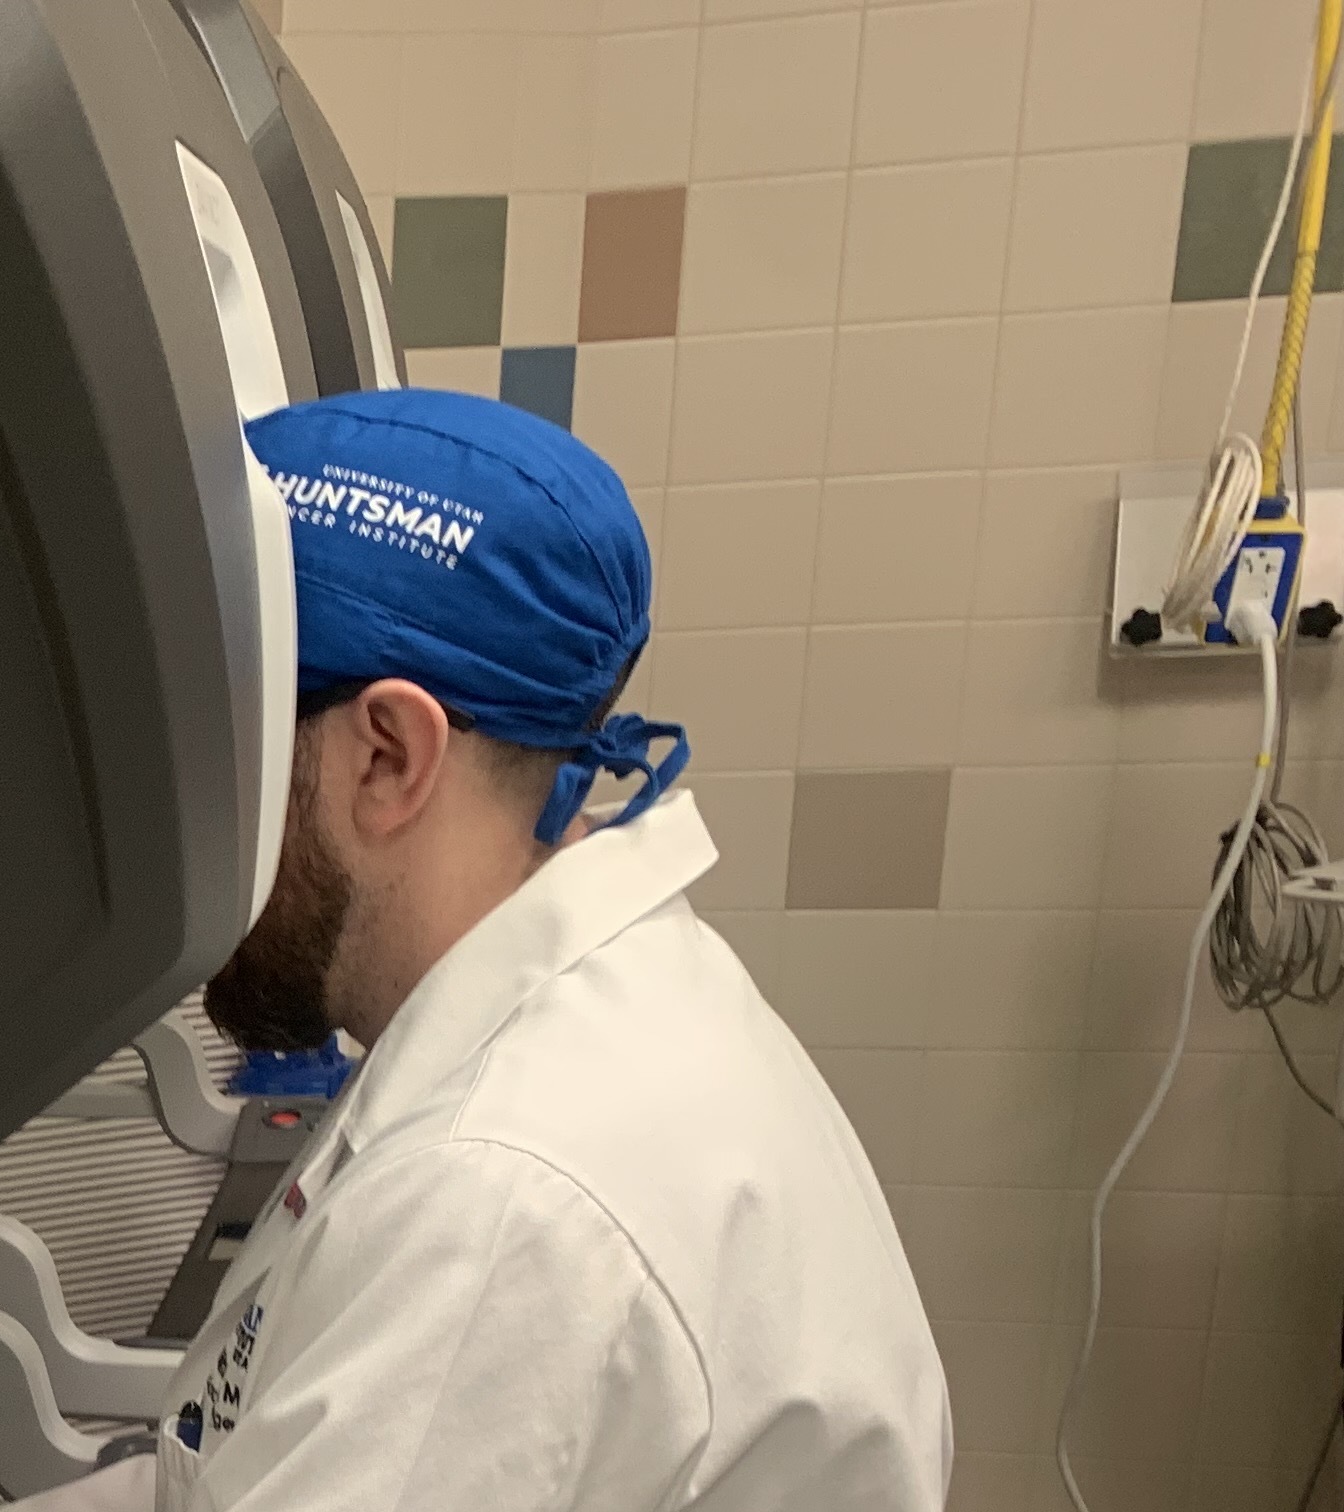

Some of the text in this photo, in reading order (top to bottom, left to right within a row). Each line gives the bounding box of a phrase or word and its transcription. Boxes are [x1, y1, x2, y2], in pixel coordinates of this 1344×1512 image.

[323, 463, 414, 499] UNIVERSITY
[417, 490, 439, 507] OF
[273, 471, 475, 554] HUNTSMAN
[349, 519, 458, 571] INSTITUTE
